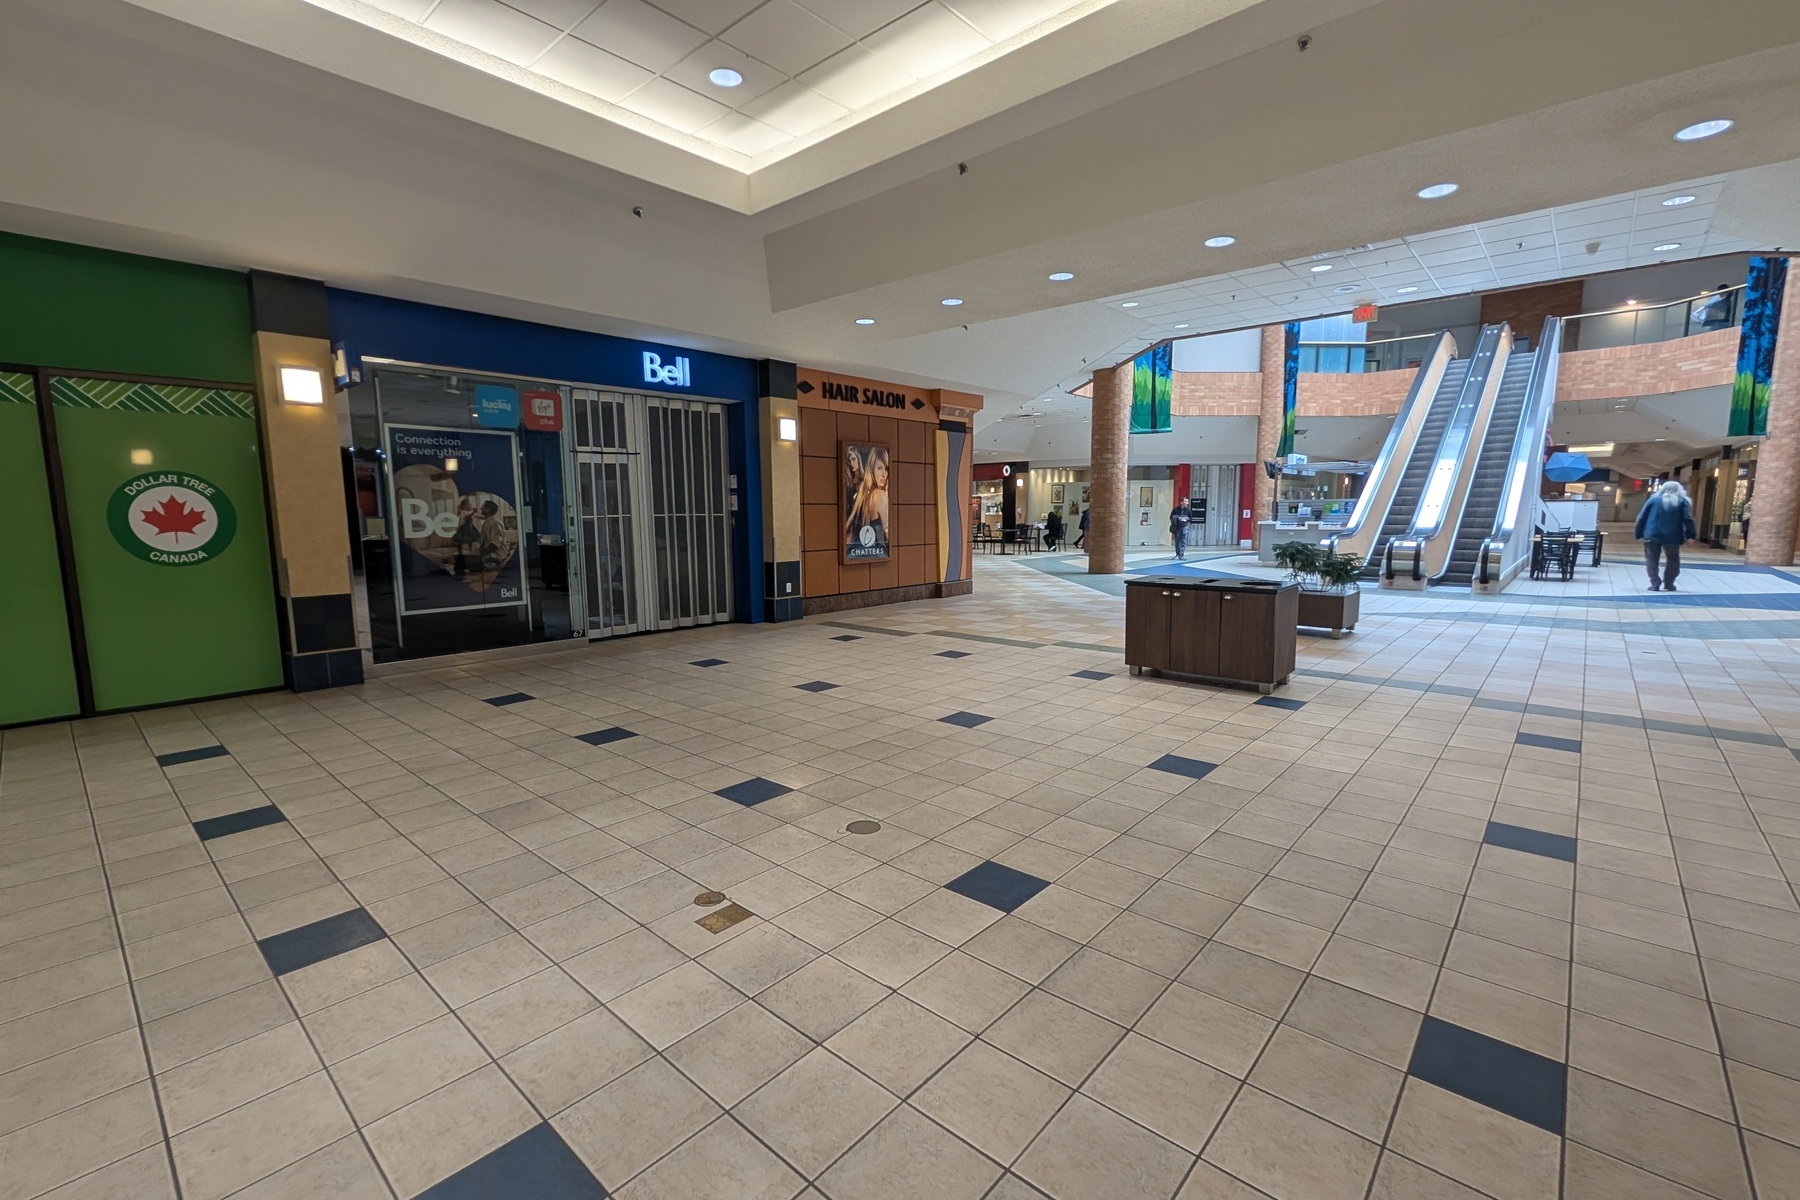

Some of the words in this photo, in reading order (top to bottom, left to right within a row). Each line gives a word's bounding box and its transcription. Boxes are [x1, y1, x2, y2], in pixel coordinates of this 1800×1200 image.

[643, 351, 691, 387] Bell
[822, 381, 859, 403] HAIR
[863, 388, 906, 410] SALON
[482, 399, 512, 412] lucky
[540, 418, 554, 426] plus
[395, 433, 462, 446] Connection
[396, 445, 408, 455] is
[410, 446, 473, 460] everything
[124, 474, 178, 496] DOLLAR
[182, 476, 216, 497] TREE
[149, 550, 209, 564] CANADA
[851, 547, 884, 556] CHATTERS
[500, 587, 518, 598] Bell
[573, 629, 584, 638] 67
